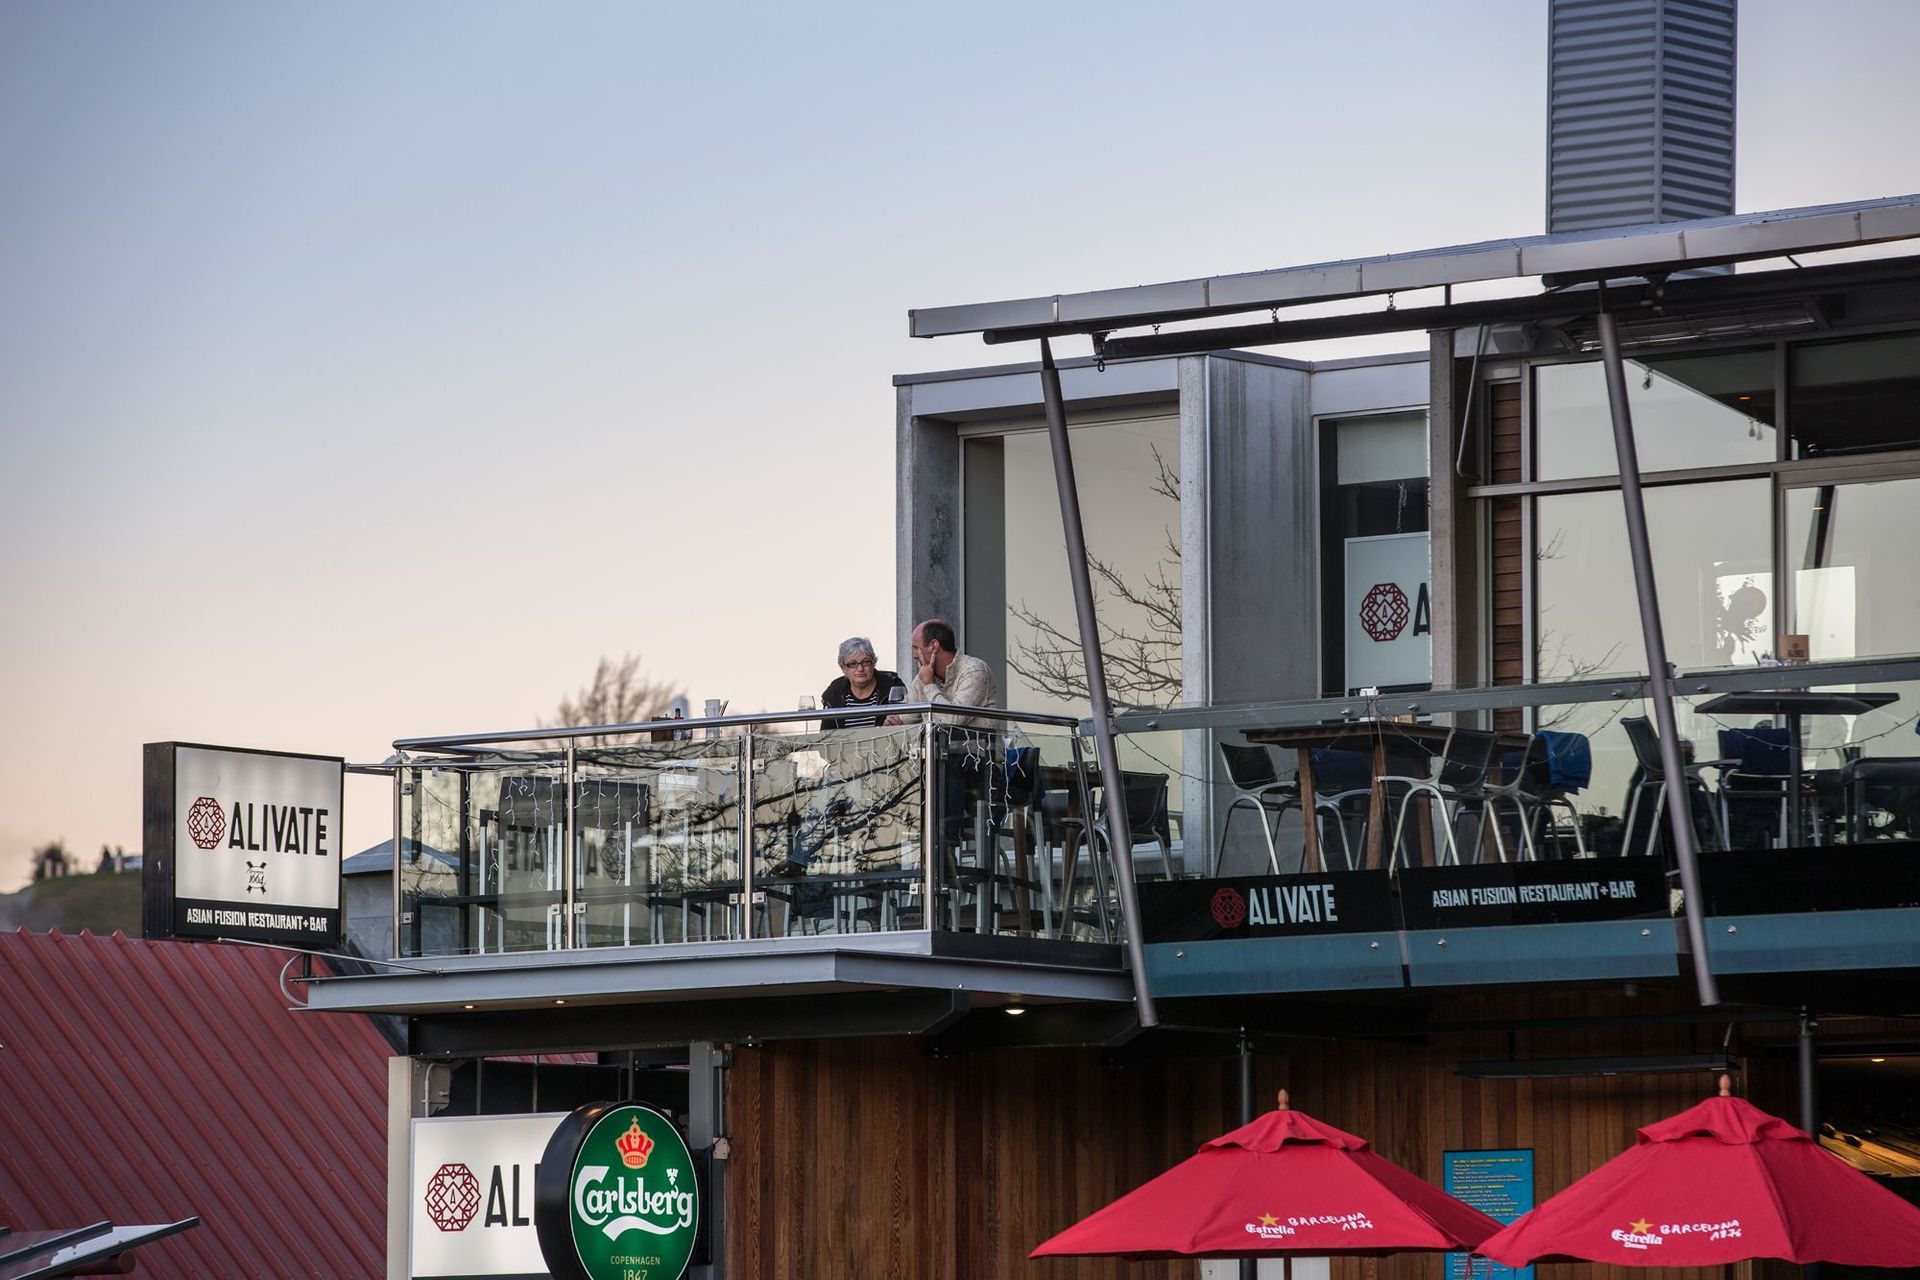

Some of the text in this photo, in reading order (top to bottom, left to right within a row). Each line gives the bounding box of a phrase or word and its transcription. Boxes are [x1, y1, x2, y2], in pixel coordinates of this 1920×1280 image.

[228, 801, 329, 856] ALIVATE
[1249, 884, 1338, 925] ALIVATE
[1433, 888, 1469, 907] ASIAN
[1471, 886, 1517, 905] FUSION
[187, 908, 213, 924] ASIAN
[214, 910, 246, 927] FUSION
[575, 1166, 694, 1228] Carlsberg
[1288, 1212, 1366, 1227] BARCELONA
[1660, 1219, 1739, 1235] BARCELONA
[1245, 1223, 1296, 1235] Estrella
[1611, 1229, 1663, 1245] Estrella
[610, 1256, 661, 1265] COPENHAGEN
